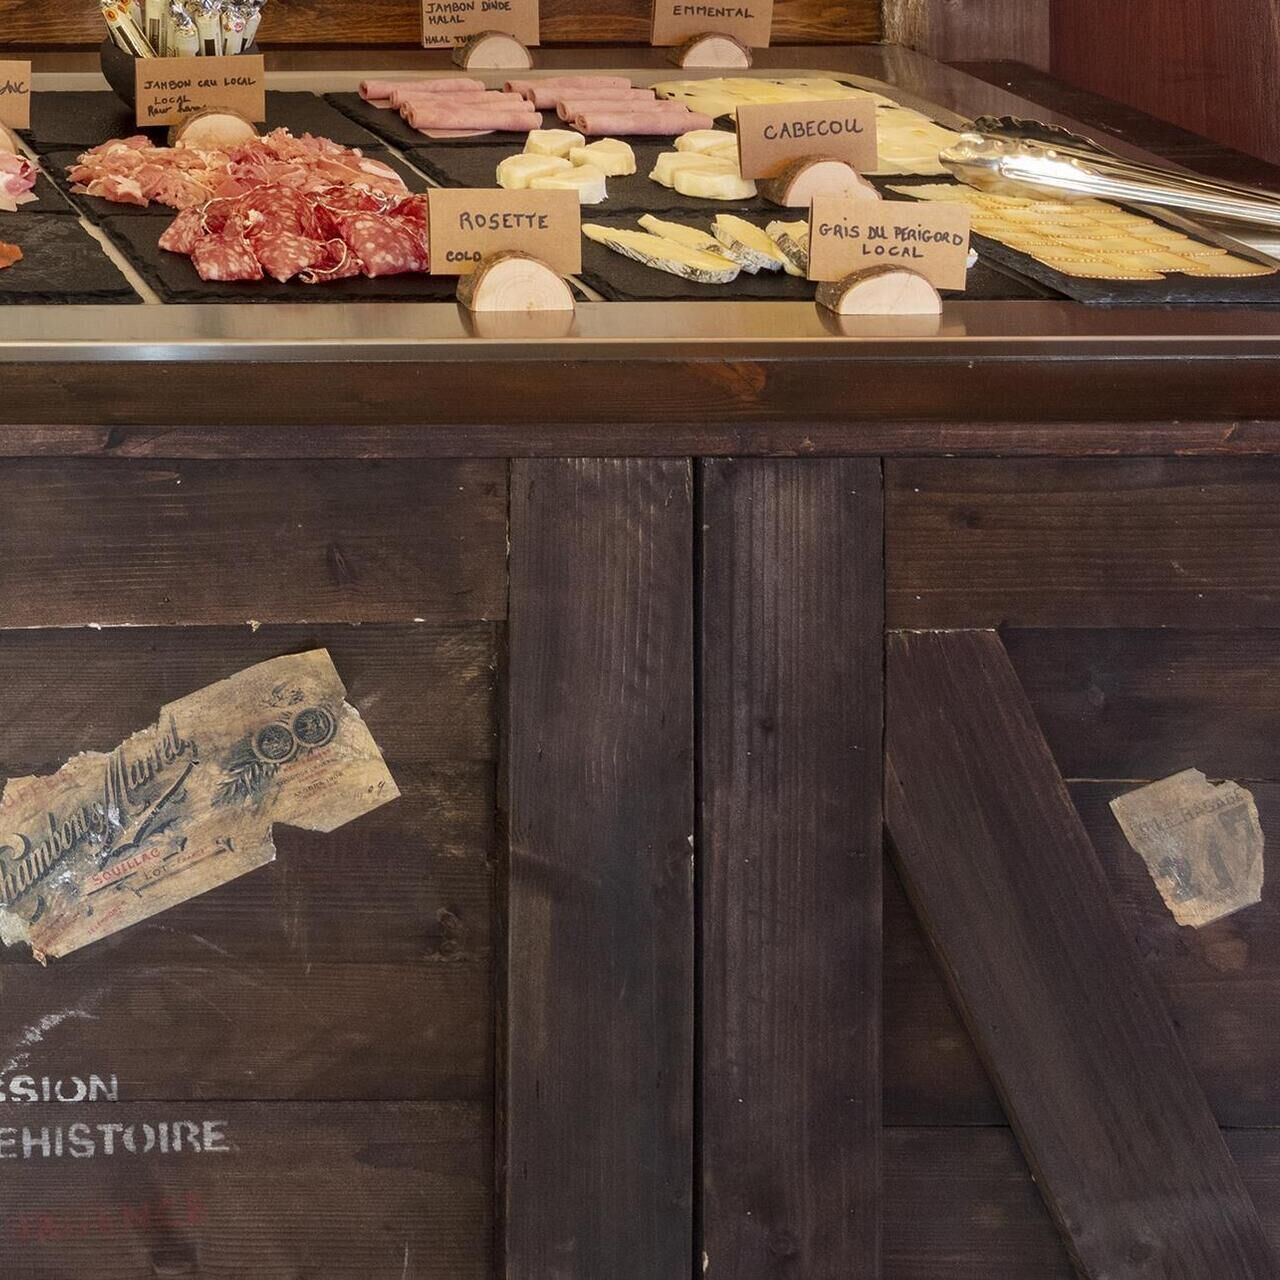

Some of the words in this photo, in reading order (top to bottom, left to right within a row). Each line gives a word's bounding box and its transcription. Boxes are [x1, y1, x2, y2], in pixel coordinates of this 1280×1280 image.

[425, 1, 475, 14] JAMBON
[673, 5, 755, 18] EMMENTAL
[428, 15, 465, 25] HALAL
[424, 35, 450, 44] HALAL
[143, 79, 192, 90] JAMBON
[224, 76, 257, 86] LOCAL
[154, 95, 192, 105] LOCAL
[763, 118, 864, 140] CABECOU
[459, 211, 549, 231] ROSETTE
[818, 217, 860, 239] GRIS
[867, 225, 889, 240] DU
[893, 223, 964, 246] PERIGORD
[446, 250, 482, 262] COLD
[862, 243, 924, 258] LOCAL
[91, 846, 161, 886] SOUILLAC
